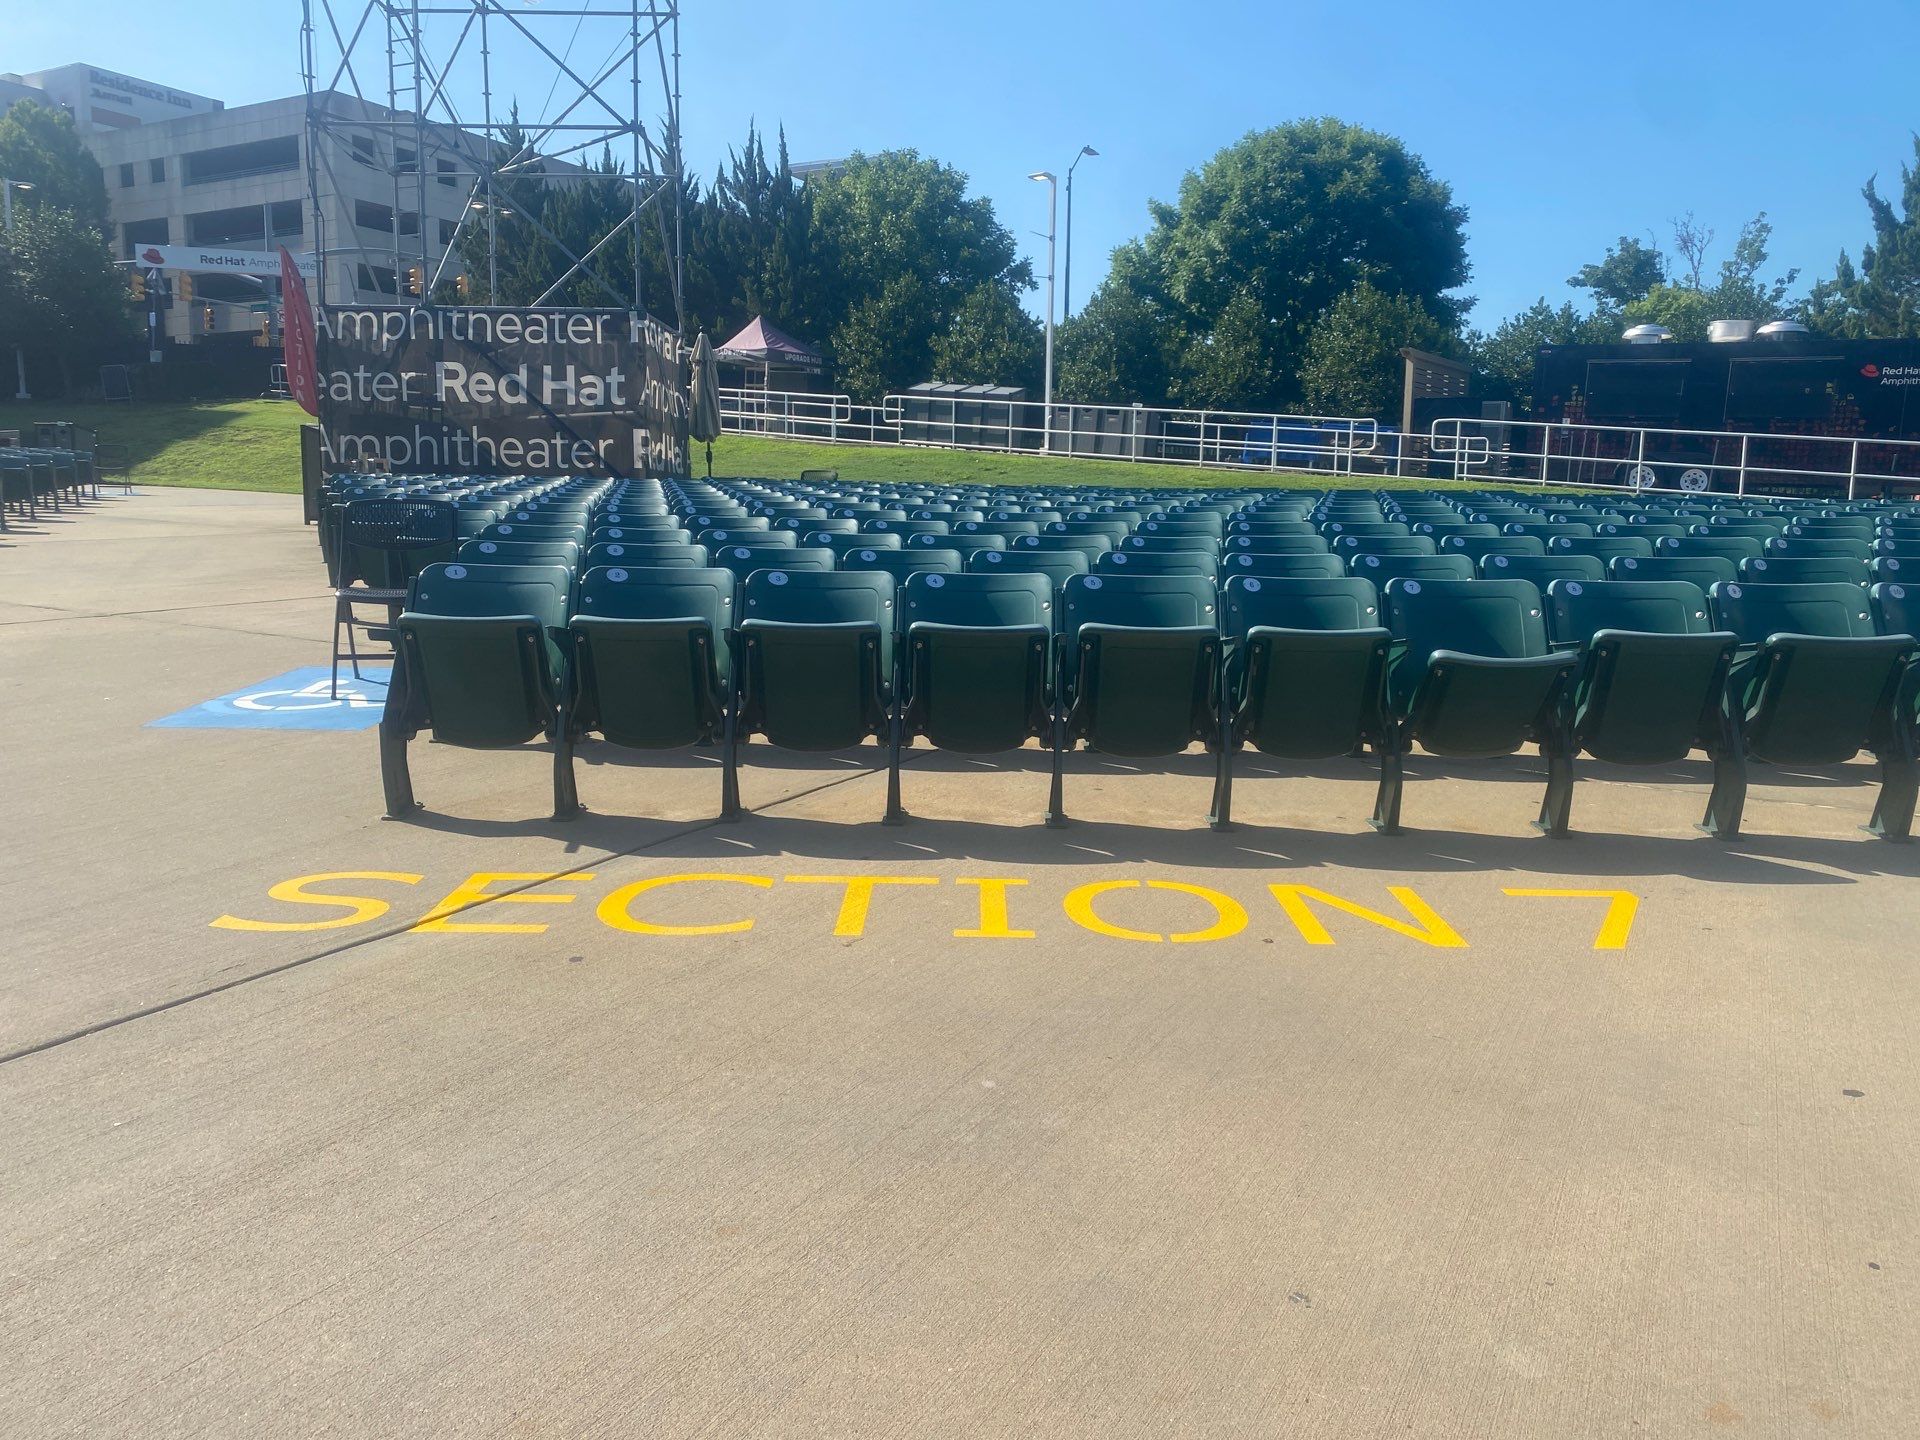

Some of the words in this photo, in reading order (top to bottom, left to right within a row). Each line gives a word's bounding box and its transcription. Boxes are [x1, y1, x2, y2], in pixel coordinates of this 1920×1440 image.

[89, 69, 164, 101] Residence
[166, 90, 192, 109] Inn
[200, 254, 223, 265] Red
[225, 256, 246, 266] Hat
[784, 352, 810, 363] UPGRADE
[1882, 366, 1903, 375] Red
[436, 361, 527, 405] Red
[543, 364, 626, 406] Hat
[208, 871, 1470, 948] SECTION
[1501, 887, 1640, 950] 7
